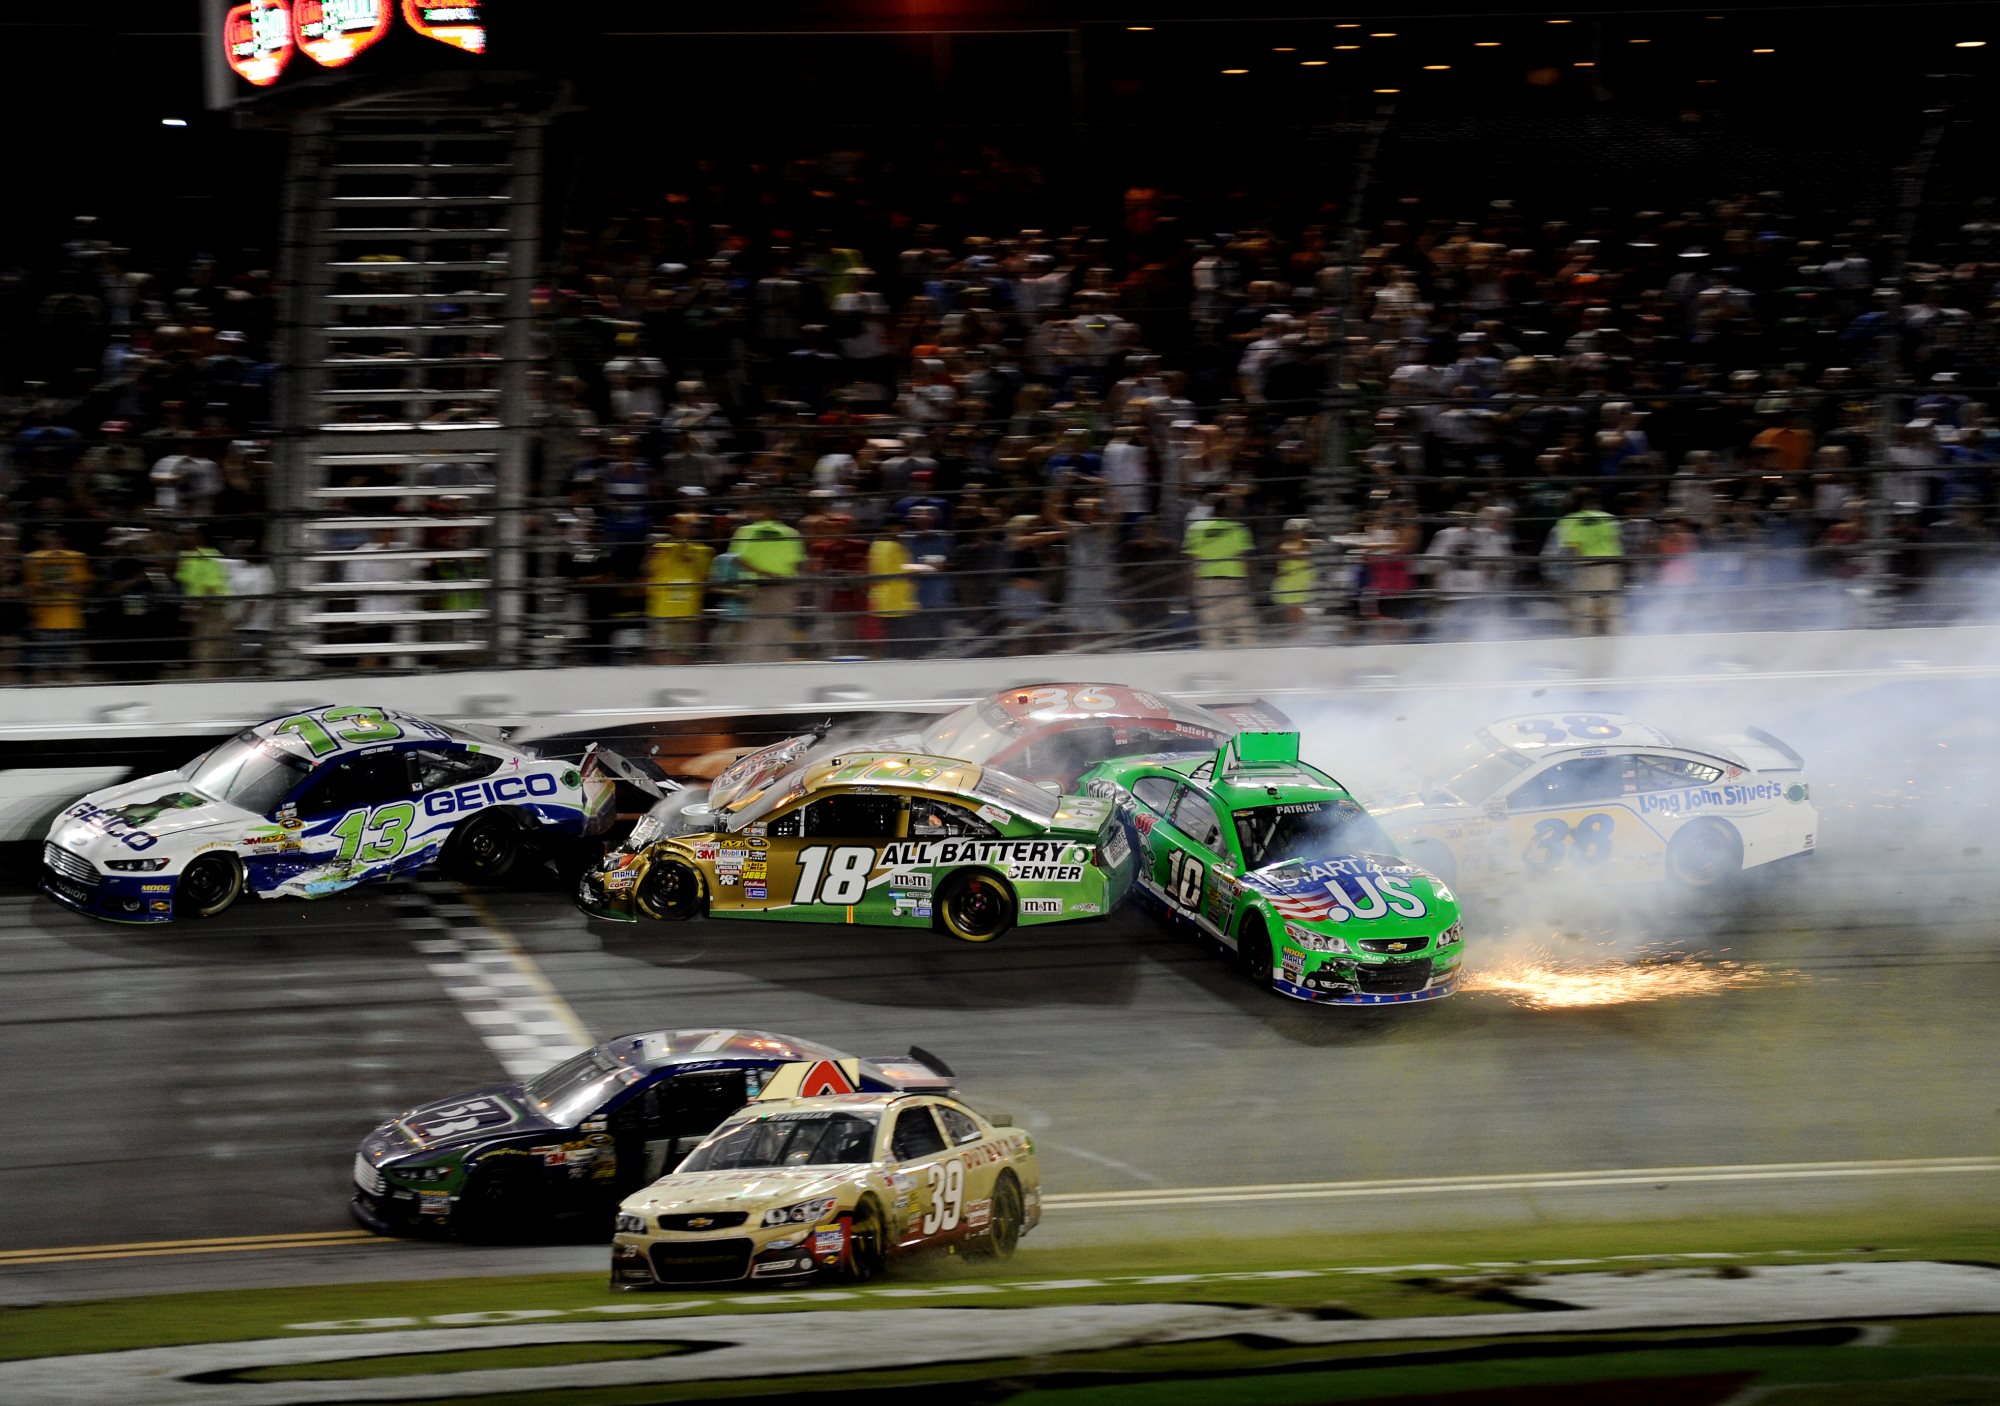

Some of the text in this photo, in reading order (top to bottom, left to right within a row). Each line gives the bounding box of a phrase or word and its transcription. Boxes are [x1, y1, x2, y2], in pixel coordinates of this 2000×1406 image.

[1031, 686, 1118, 719] 36
[273, 695, 406, 758] 13
[1515, 715, 1623, 744] 38
[421, 771, 559, 818] GEICO
[1276, 803, 1322, 815] PATRICK
[1637, 780, 1782, 814] Long John Silver's
[65, 802, 159, 852] GEICO
[243, 836, 262, 846] 3M
[329, 801, 416, 864] 13
[1523, 812, 1616, 871] 38
[696, 849, 716, 860] 3M
[880, 842, 1069, 866] ALL BATTERY
[611, 871, 640, 879] MAHLE
[742, 872, 767, 880] JEGS
[791, 844, 877, 906] 18
[1008, 865, 1082, 881] CENTER
[1164, 849, 1207, 914] 10
[1282, 954, 1305, 966] MAHLE
[1283, 947, 1306, 959] MOOG
[922, 1158, 965, 1235] 39
